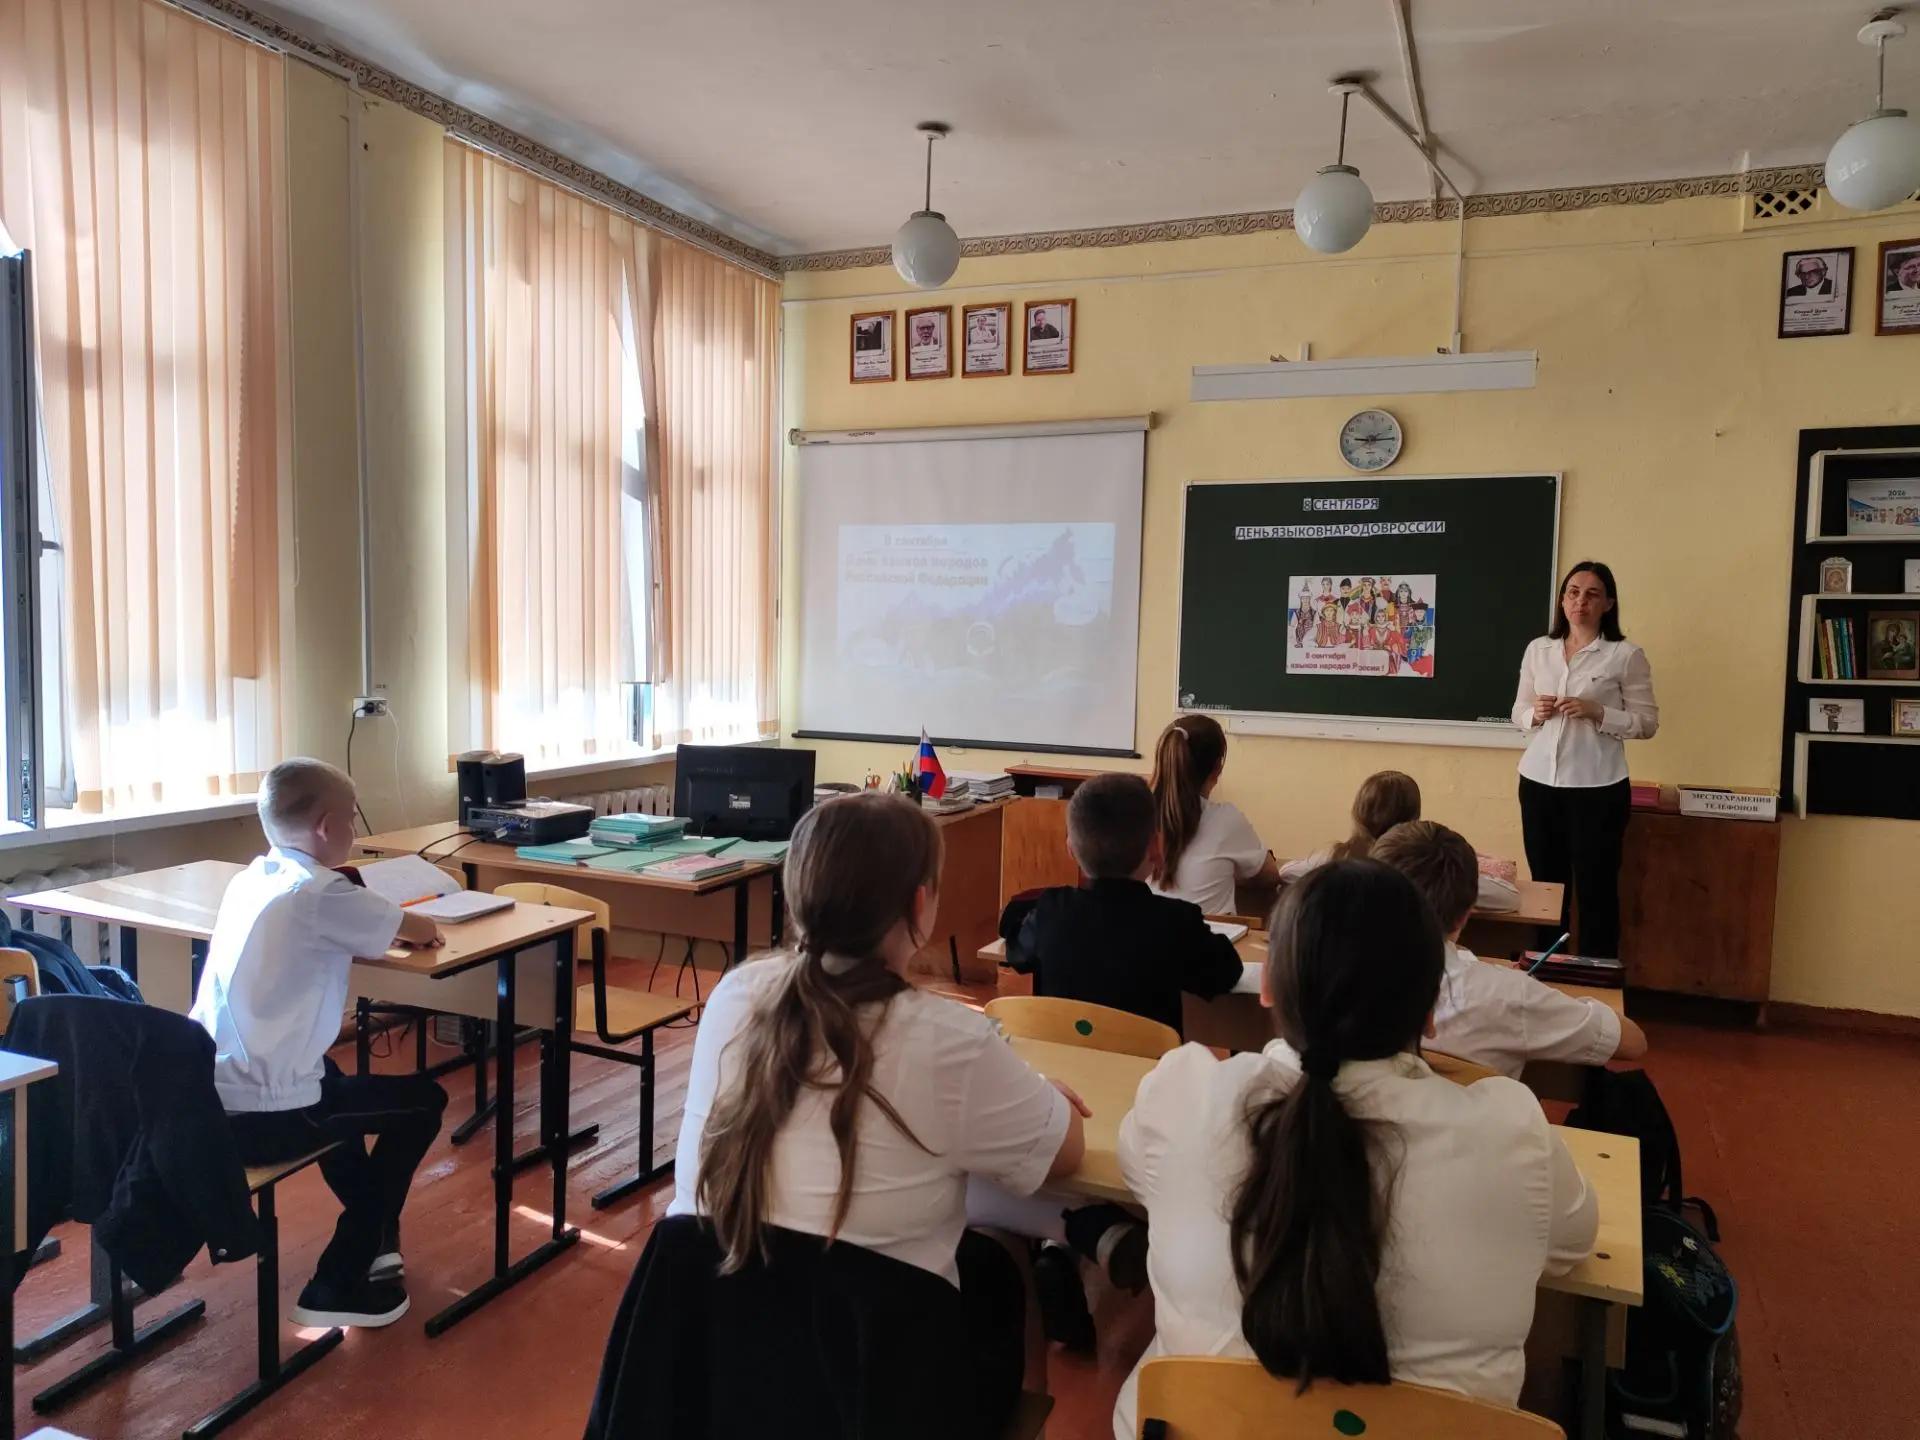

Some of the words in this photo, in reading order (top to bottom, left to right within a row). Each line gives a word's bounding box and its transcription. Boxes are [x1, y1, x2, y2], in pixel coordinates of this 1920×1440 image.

[1304, 499, 1311, 510] 8
[1313, 499, 1379, 510] СЕНТЯБРЯ
[1236, 527, 1269, 539] ДЕНЬ
[1311, 651, 1346, 660] сентября
[1320, 663, 1351, 671] народов
[1692, 792, 1724, 800] МЕСТО
[1725, 793, 1771, 803] ХРАНЕНИЯ
[1704, 803, 1759, 812] ТЕЛЕФОНОВ
